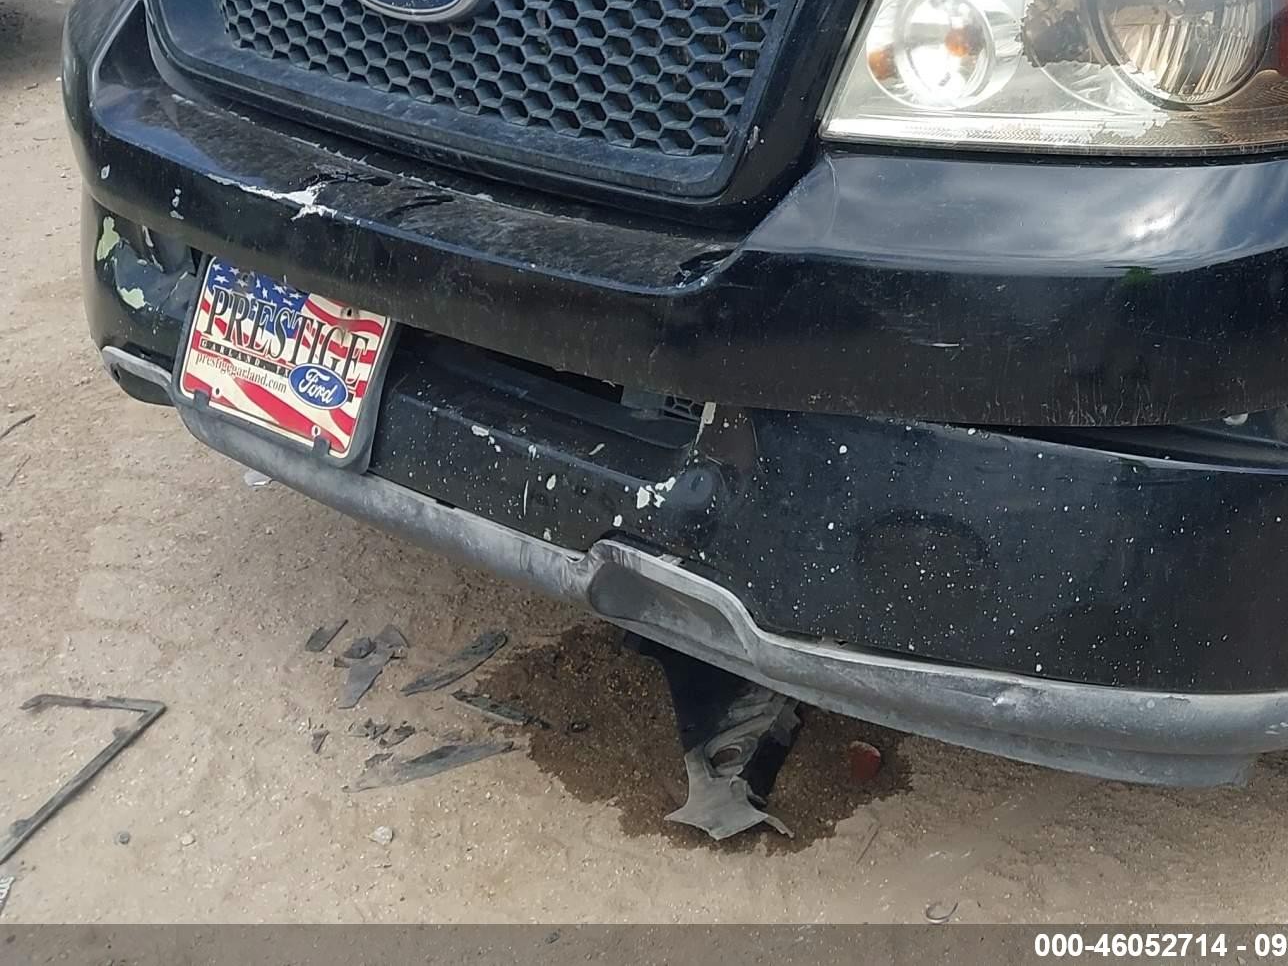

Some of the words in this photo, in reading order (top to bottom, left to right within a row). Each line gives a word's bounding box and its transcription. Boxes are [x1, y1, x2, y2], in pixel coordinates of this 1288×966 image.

[203, 286, 370, 389] PRESTIGE
[194, 351, 288, 394] prestigegarland.com
[298, 368, 339, 405] Ford
